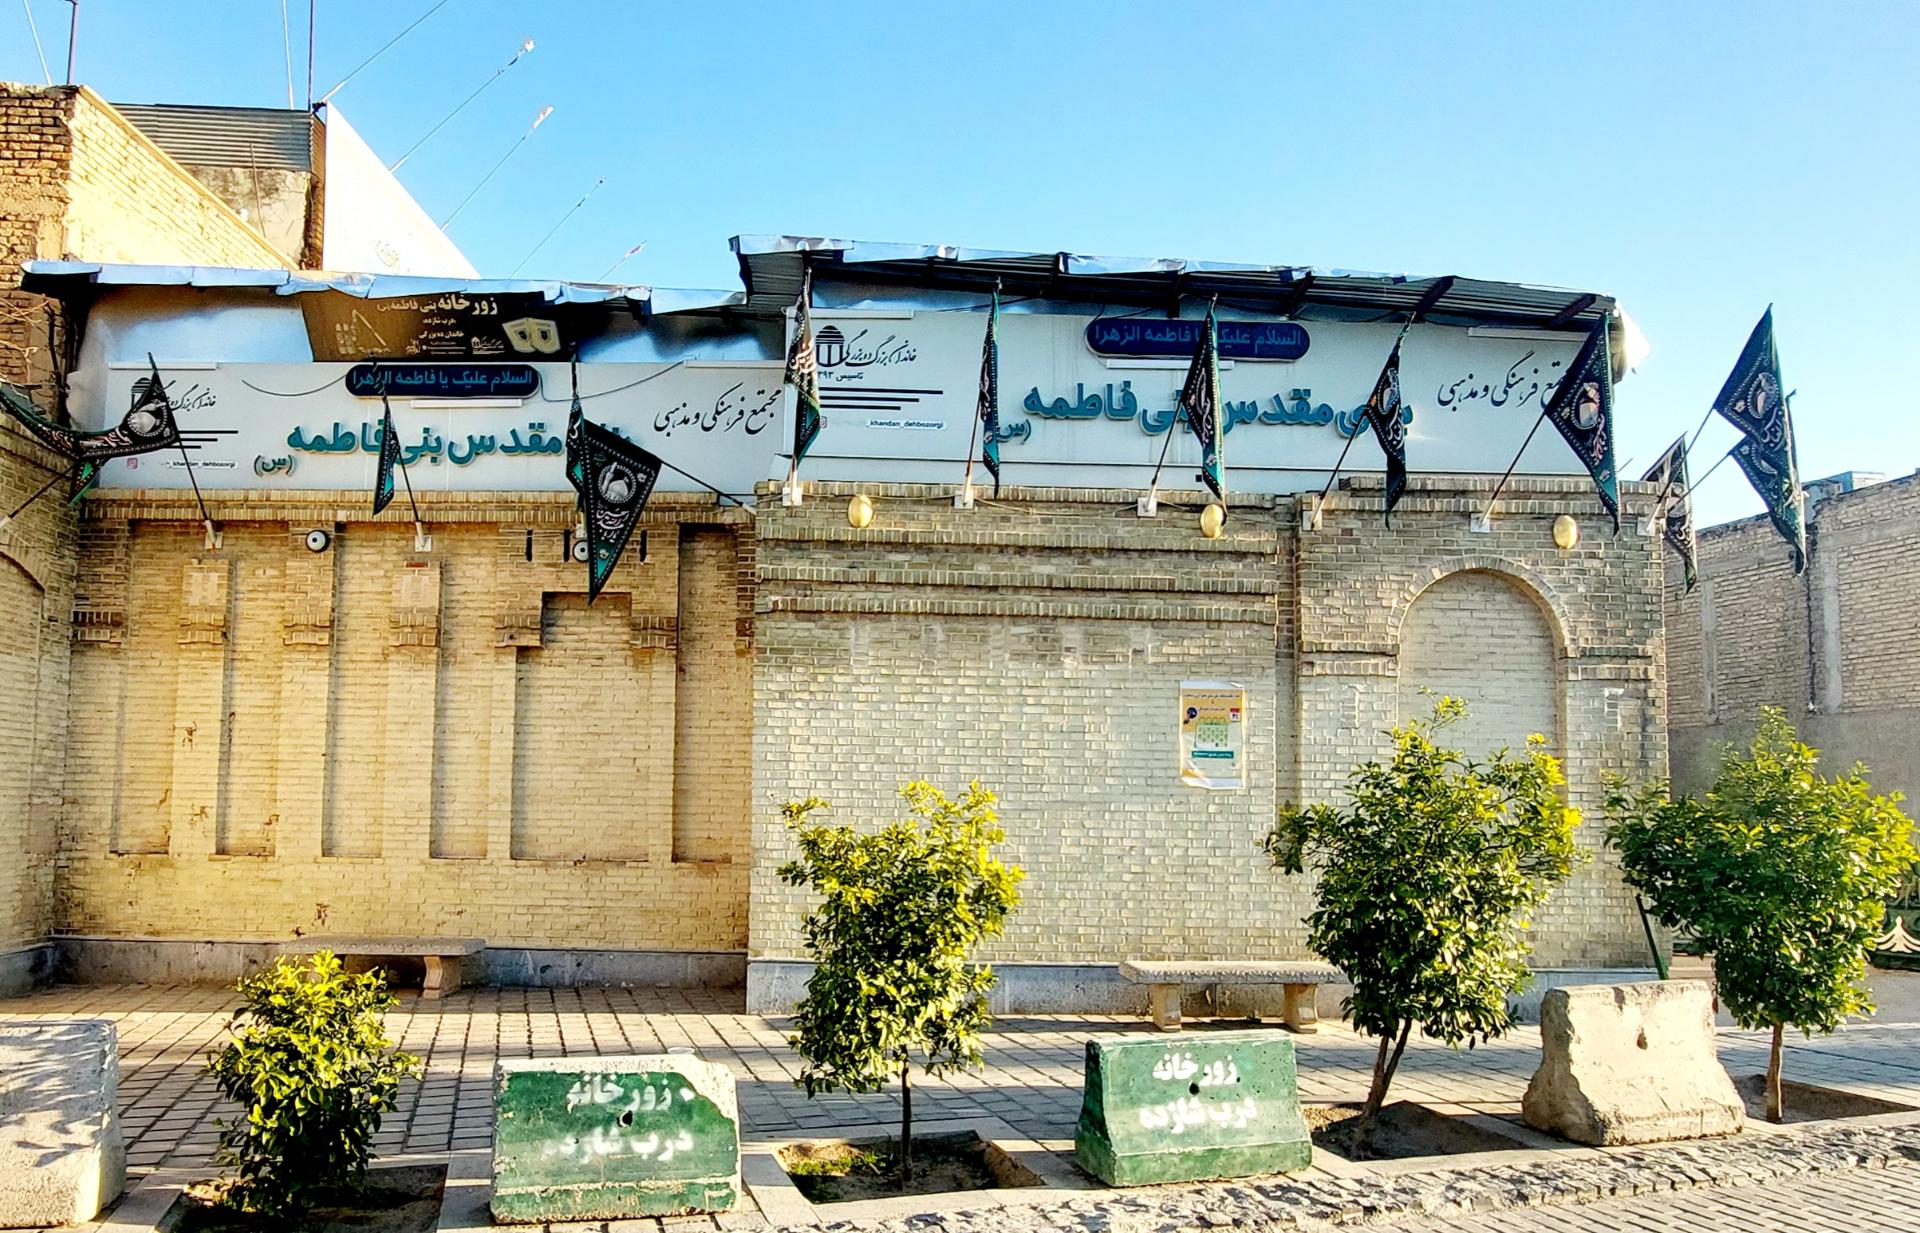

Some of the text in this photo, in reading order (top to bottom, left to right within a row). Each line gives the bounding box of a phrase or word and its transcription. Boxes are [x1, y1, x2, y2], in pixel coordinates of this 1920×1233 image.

[390, 299, 418, 311] فاطمه
[1095, 325, 1140, 345] الزهرا
[1145, 325, 1190, 343] فاطمه
[1255, 329, 1302, 353] السلام
[395, 370, 436, 385] فاطمه
[438, 371, 449, 389] یا
[452, 370, 487, 389] علیک
[491, 370, 532, 392] السلام
[1490, 350, 1539, 408] فرهنگی
[701, 381, 745, 433] فرهنگی
[1023, 380, 1138, 420] فاطمه
[653, 402, 690, 438] مذهبی
[745, 389, 782, 435] مجتمع
[449, 422, 563, 466] مقدس
[253, 454, 294, 477] (س)
